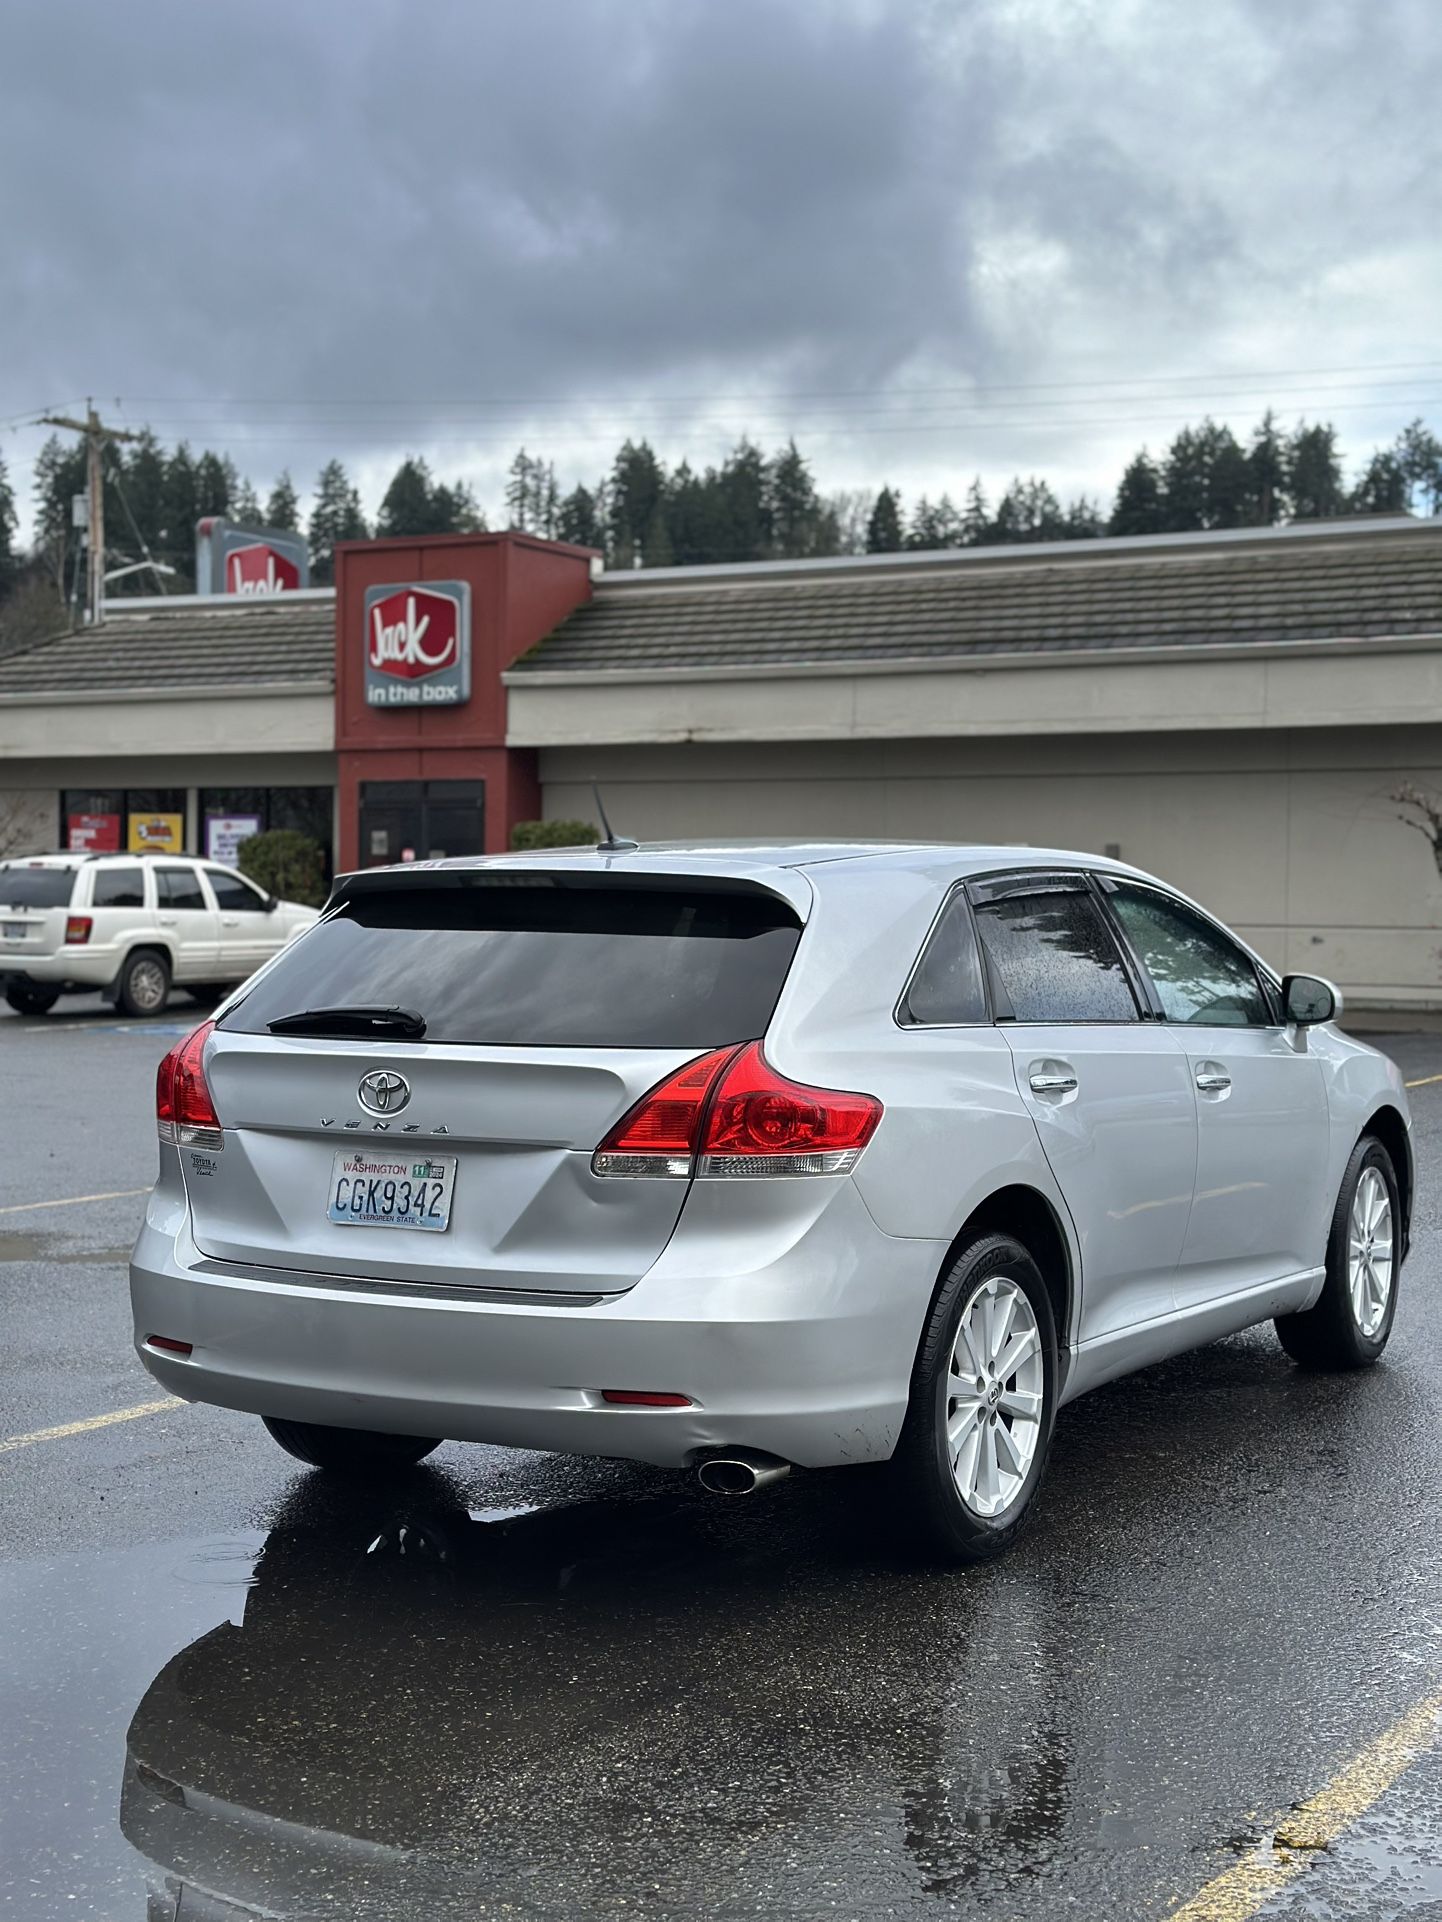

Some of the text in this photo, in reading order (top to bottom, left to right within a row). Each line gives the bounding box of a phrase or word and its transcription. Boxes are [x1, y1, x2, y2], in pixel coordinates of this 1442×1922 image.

[370, 596, 454, 667] Jack
[367, 683, 459, 703] in the box
[320, 1118, 450, 1135] VENZA
[342, 1161, 407, 1176] WASHINGTON
[413, 1165, 425, 1176] 11
[335, 1177, 444, 1218] CGK9342
[358, 1213, 416, 1224] EVERGREEN STATE
